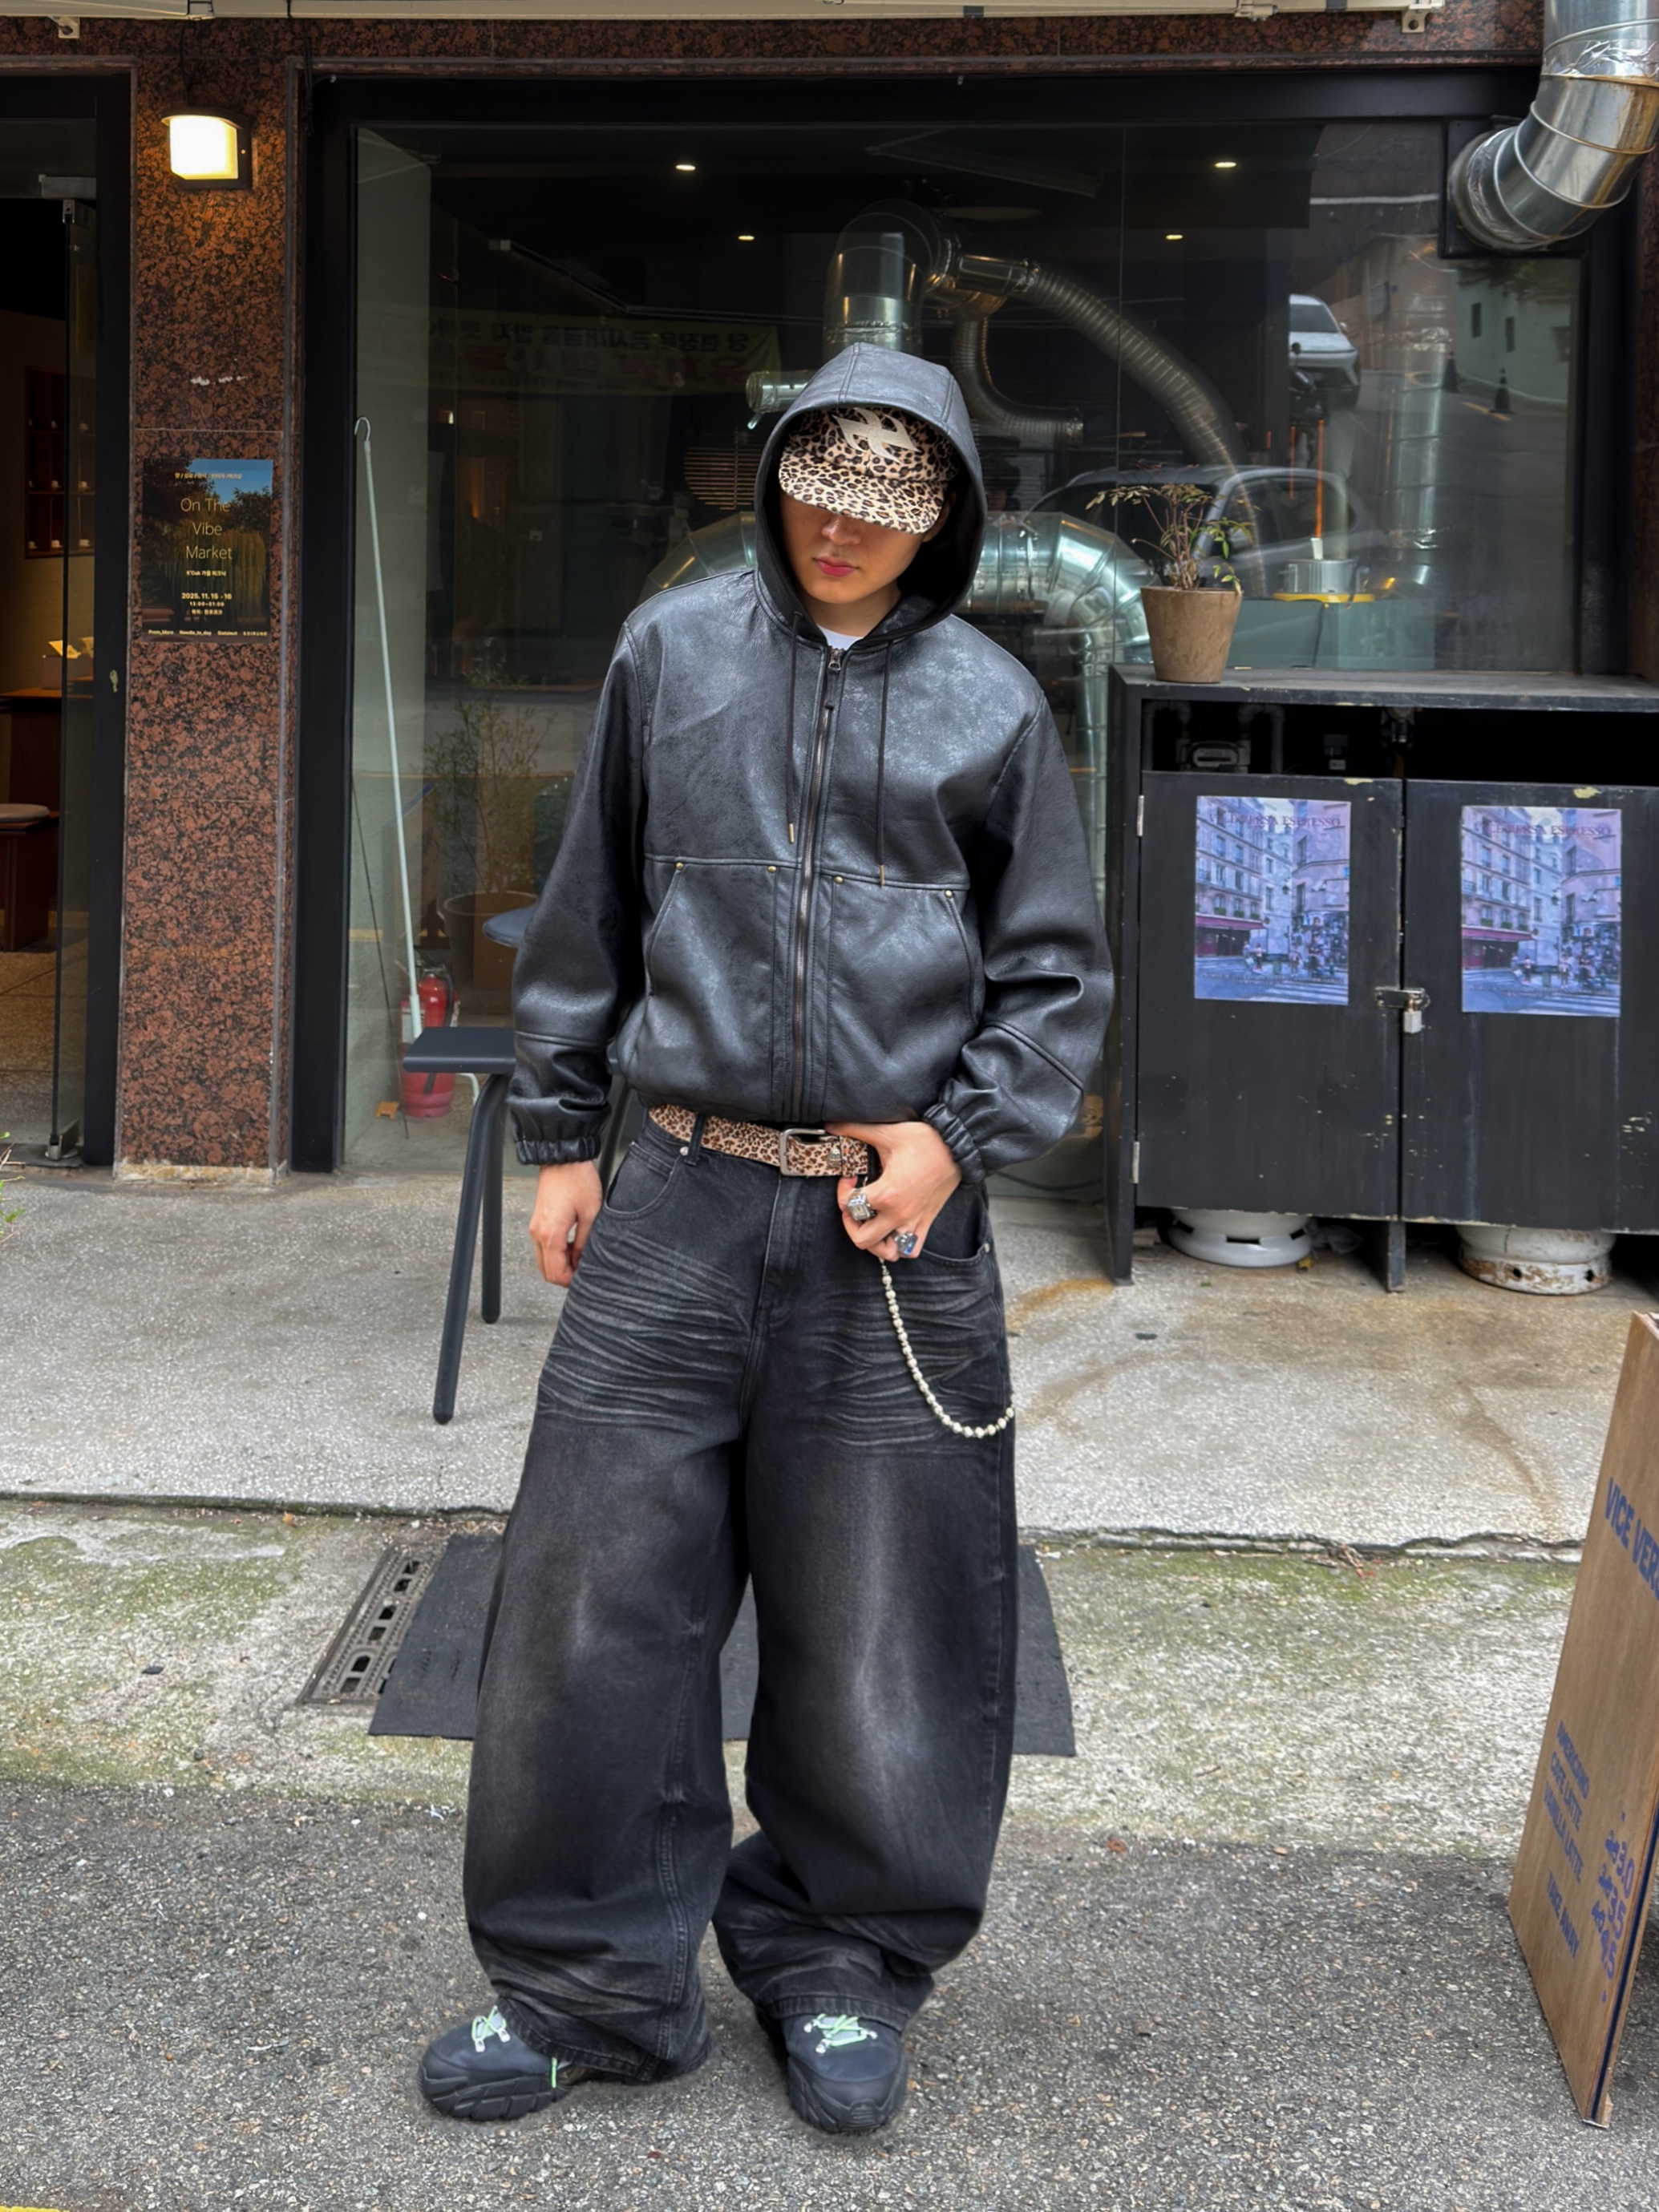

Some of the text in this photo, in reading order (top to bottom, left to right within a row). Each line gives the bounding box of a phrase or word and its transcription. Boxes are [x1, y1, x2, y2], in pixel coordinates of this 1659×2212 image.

[180, 498, 231, 512] On The
[192, 522, 223, 536] Vibe
[185, 545, 233, 560] Market
[181, 592, 200, 601] 2025.
[211, 592, 219, 601] 15
[1283, 815, 1341, 826] ESPRESSO
[1551, 825, 1611, 835] ESPRESSO
[1605, 1477, 1635, 1551] VICE
[1556, 1720, 1590, 1799] AMERICANO
[1550, 1750, 1584, 1834] CAFE LATTE
[1544, 1779, 1584, 1885] VANILLA LATTE
[1547, 1869, 1580, 1959] TAKE AWAY
